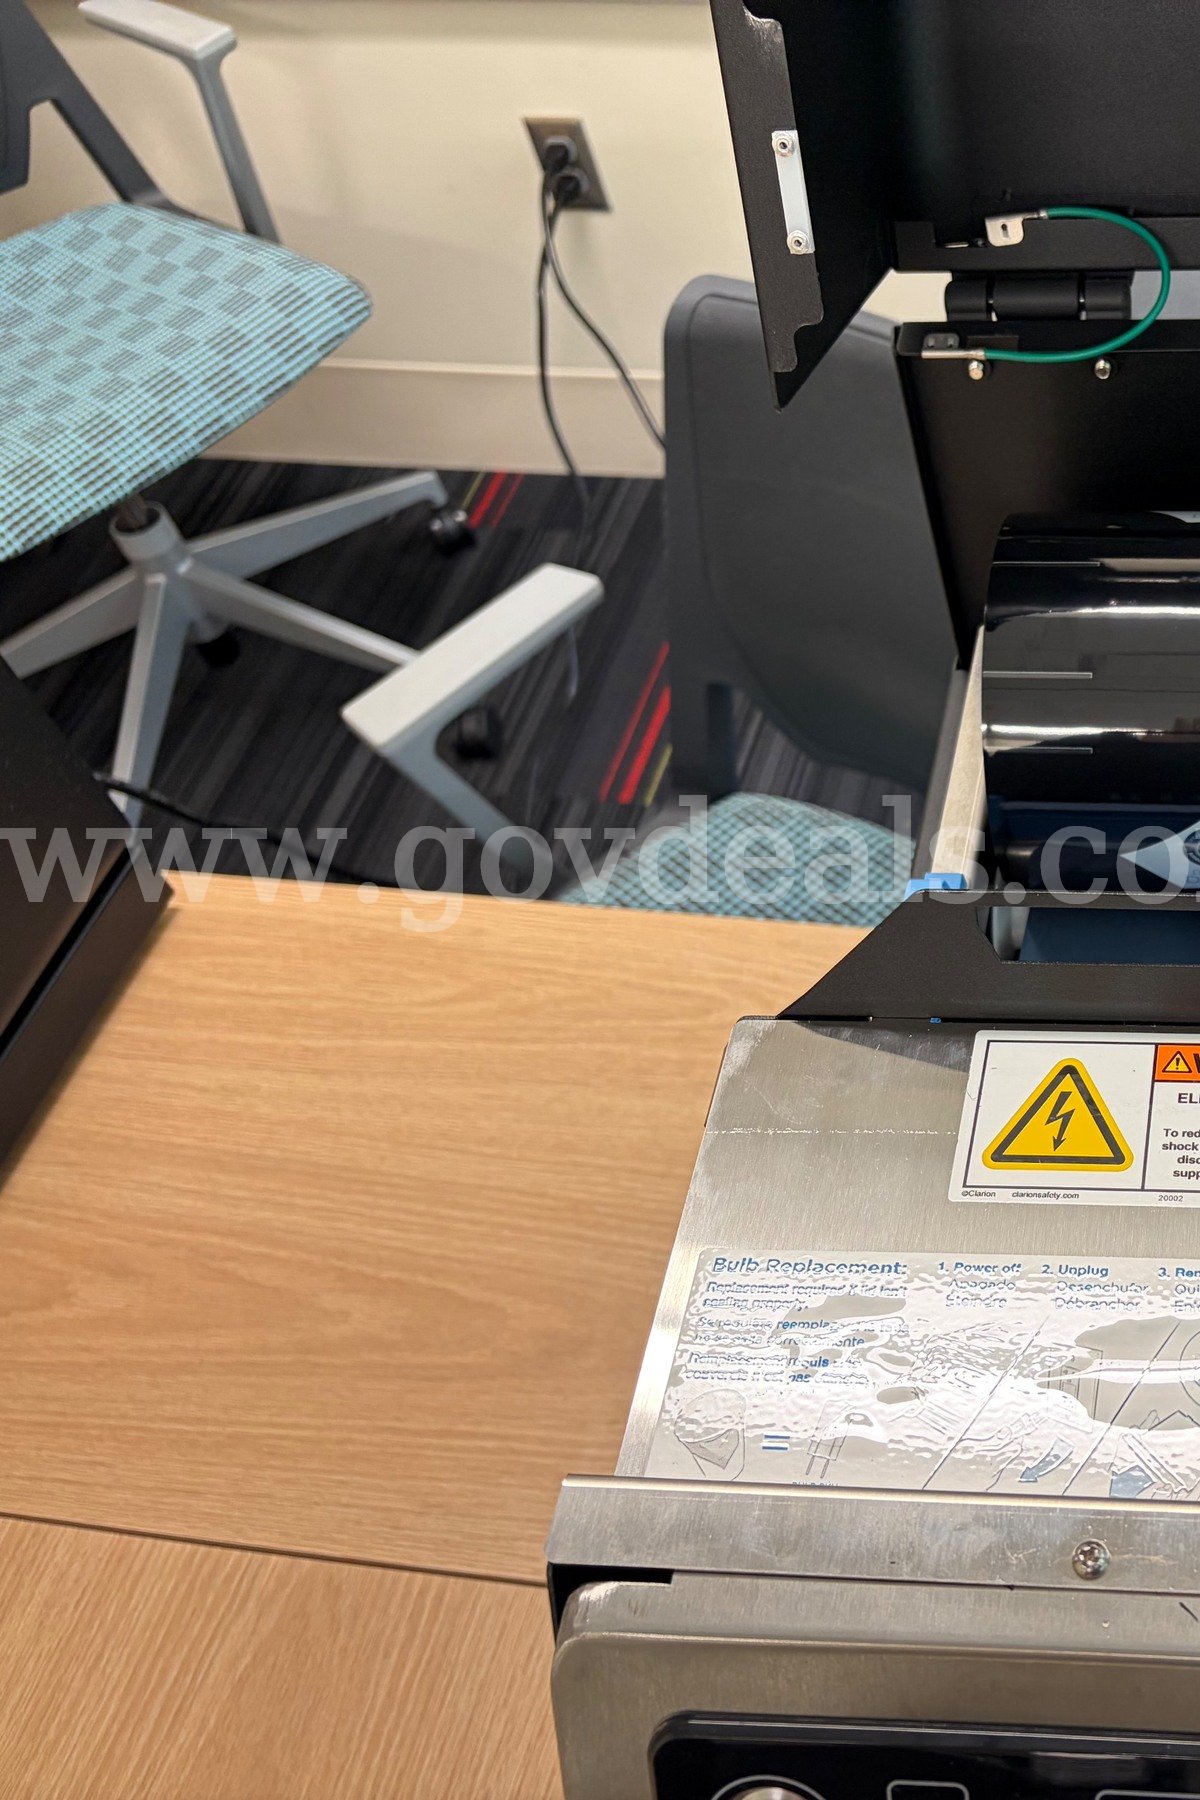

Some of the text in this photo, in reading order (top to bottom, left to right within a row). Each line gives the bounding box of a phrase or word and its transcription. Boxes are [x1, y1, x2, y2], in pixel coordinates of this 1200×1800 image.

[1163, 1128, 1178, 1138] To
[1162, 1142, 1199, 1152] shock
[1012, 1191, 1080, 1199] clarionsafety.com
[712, 1257, 908, 1275] Bulb Replacement:
[938, 1262, 949, 1272] 1.
[953, 1262, 998, 1274] Power
[1041, 1264, 1109, 1277] 2. Unplug
[1158, 1267, 1170, 1278] 3.
